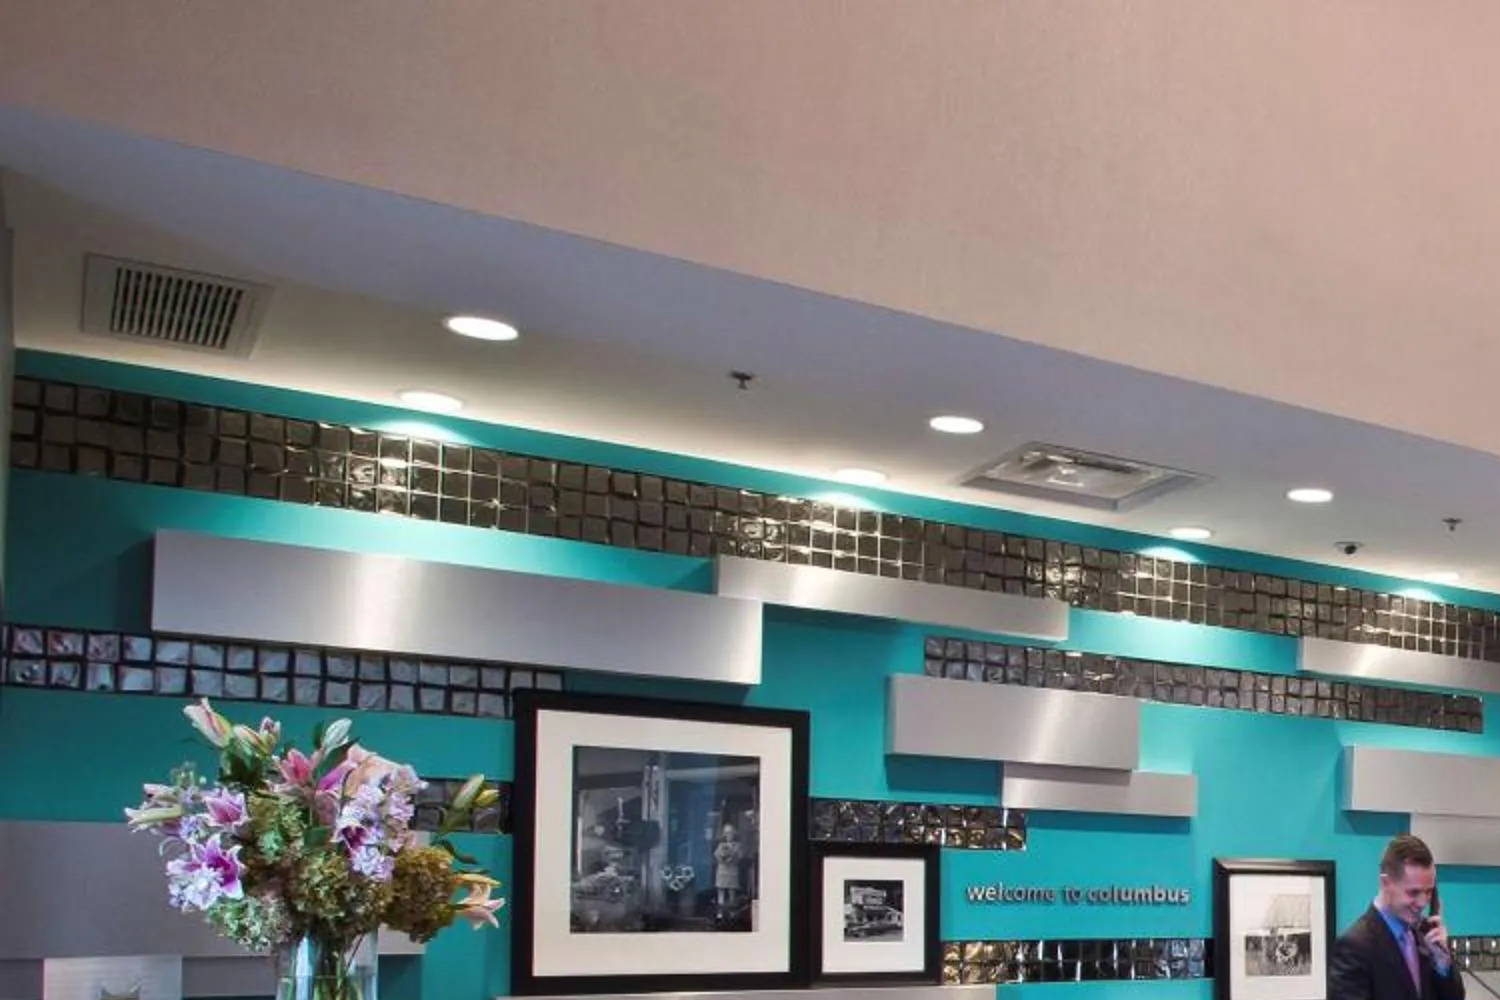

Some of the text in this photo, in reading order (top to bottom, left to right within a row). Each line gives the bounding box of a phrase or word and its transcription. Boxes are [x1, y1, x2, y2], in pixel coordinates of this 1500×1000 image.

[967, 881, 1190, 905] welcome to columbus
